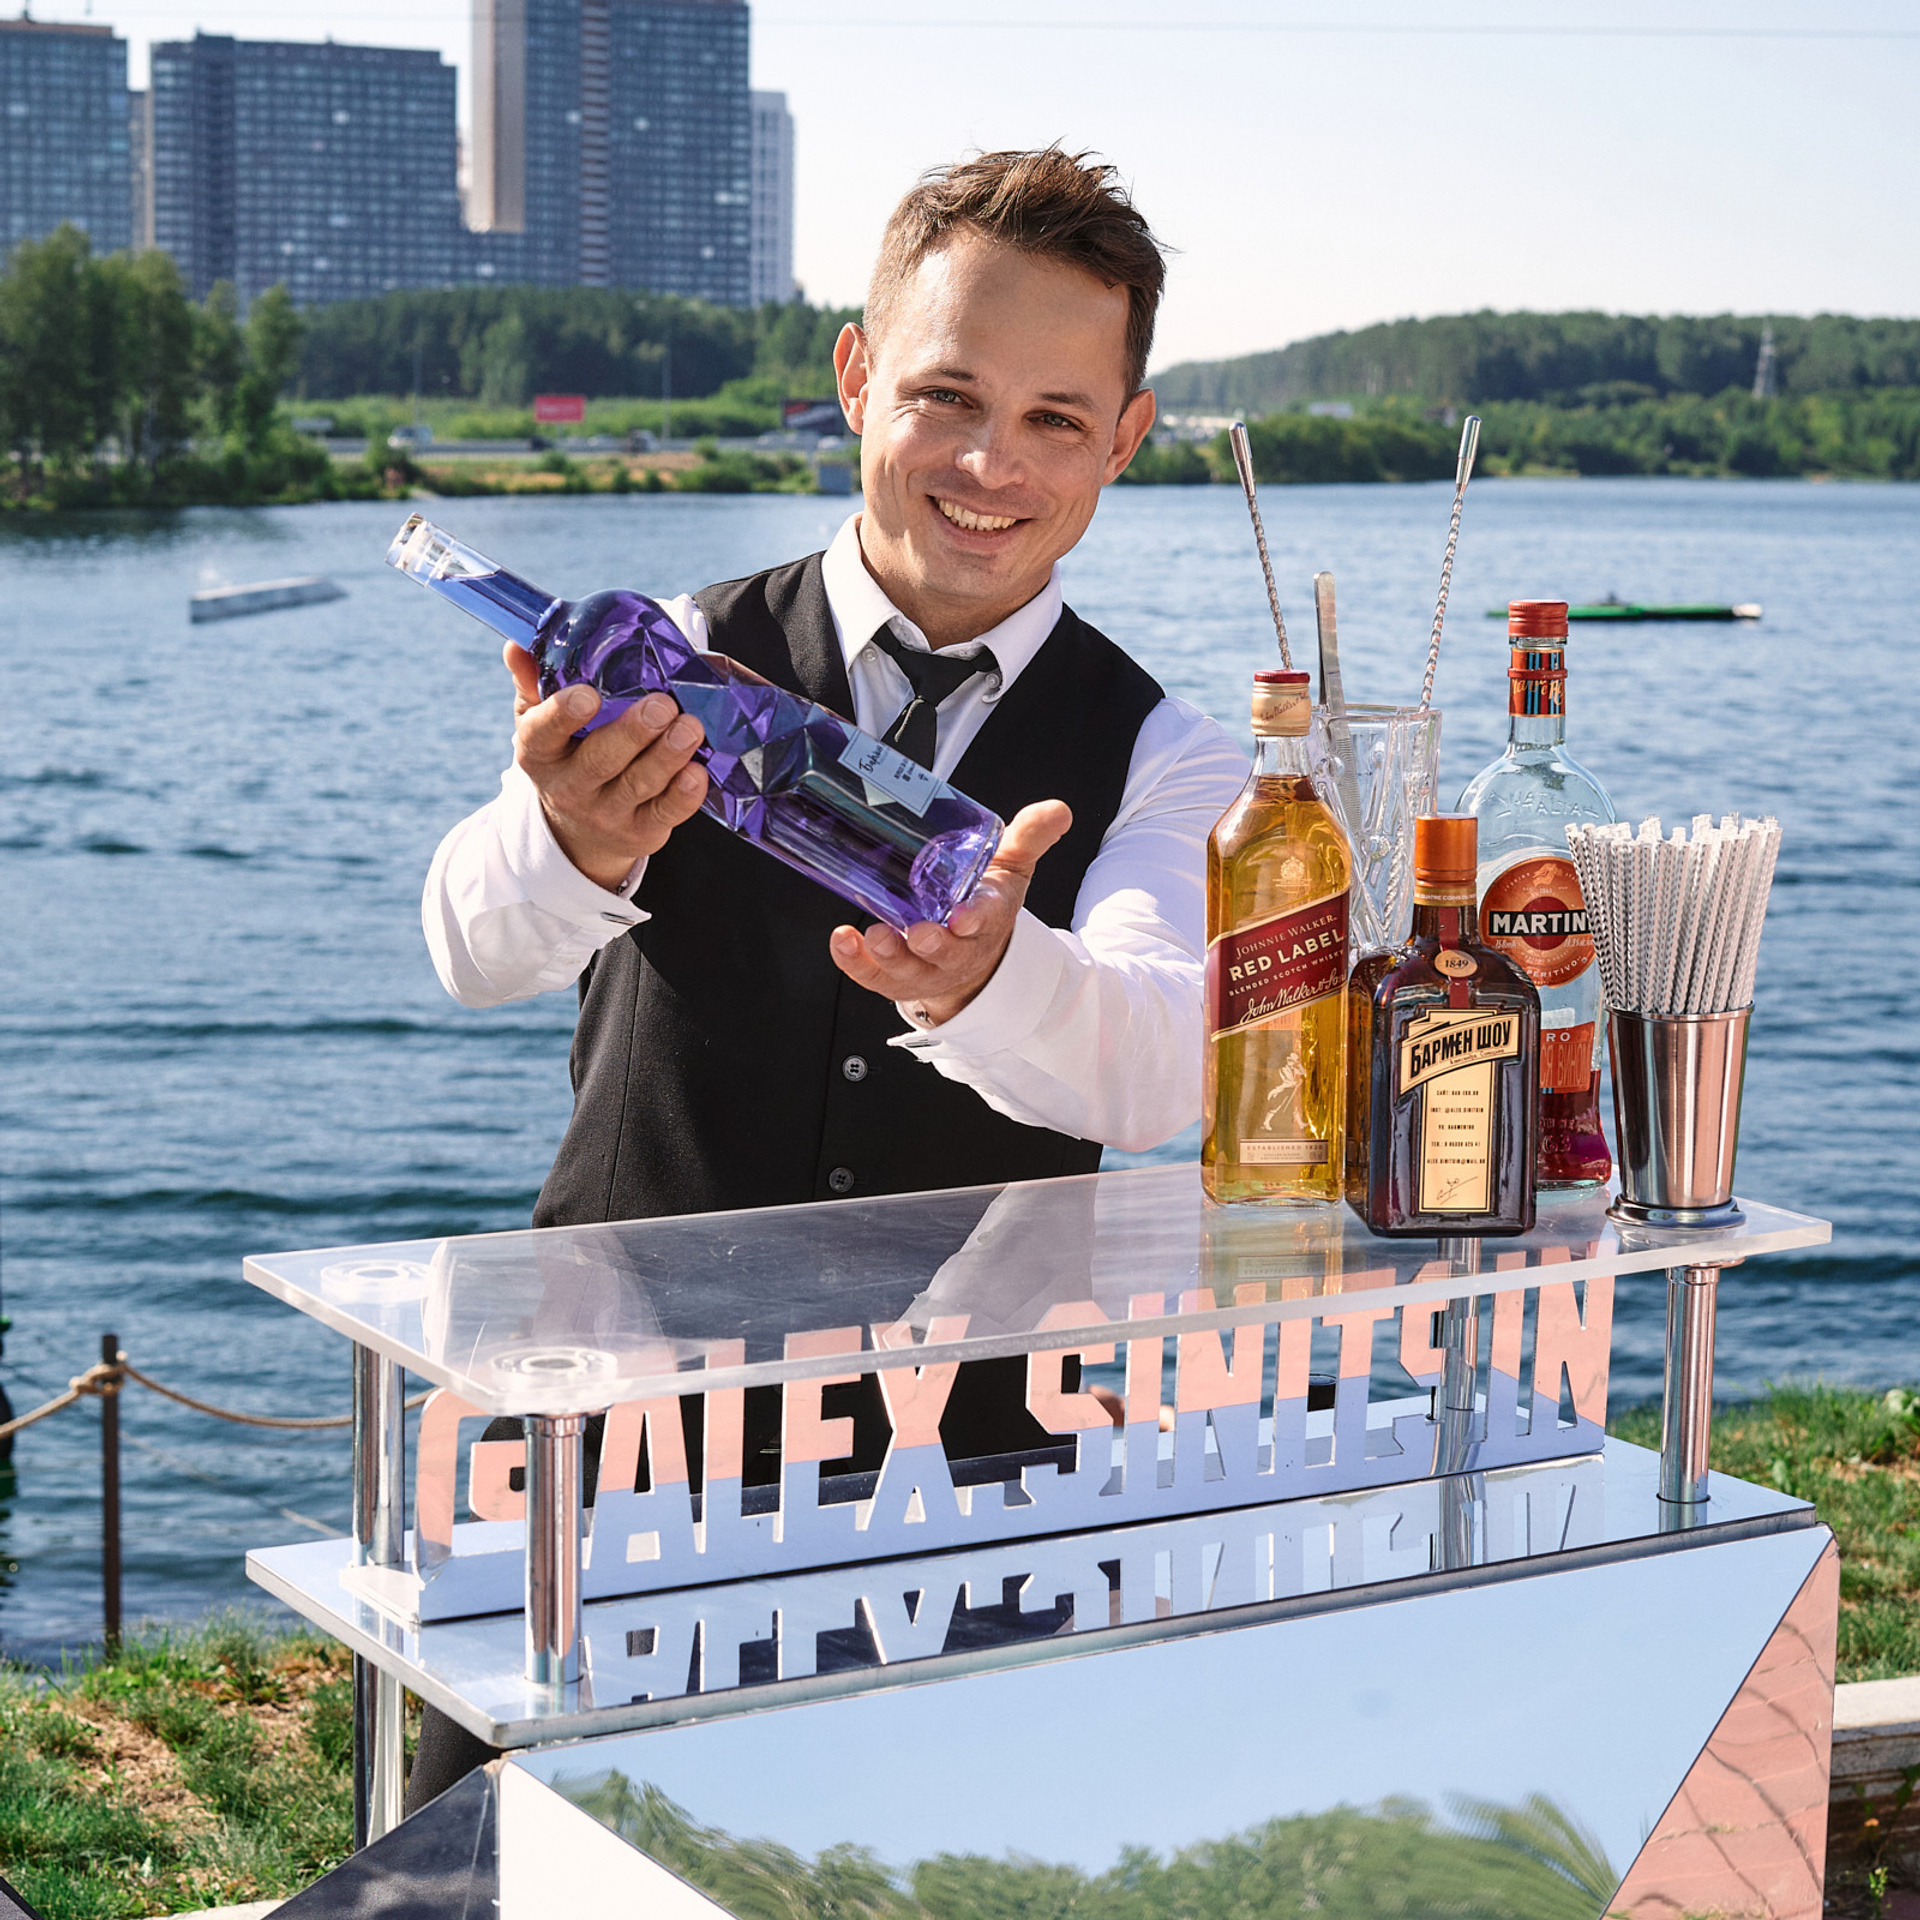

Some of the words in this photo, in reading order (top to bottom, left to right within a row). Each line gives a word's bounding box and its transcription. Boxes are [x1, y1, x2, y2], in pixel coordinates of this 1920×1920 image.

[1229, 955, 1272, 982] RED
[1277, 928, 1344, 964] LABEL
[1236, 932, 1286, 960] JOHNNIE
[1445, 959, 1468, 969] 1849
[1229, 979, 1270, 997] BLENDED
[1273, 963, 1308, 981] SCOTCH
[1311, 949, 1344, 966] WHISKY
[1410, 1029, 1473, 1079] БАРМЕН
[1477, 1020, 1511, 1050] ШОУ
